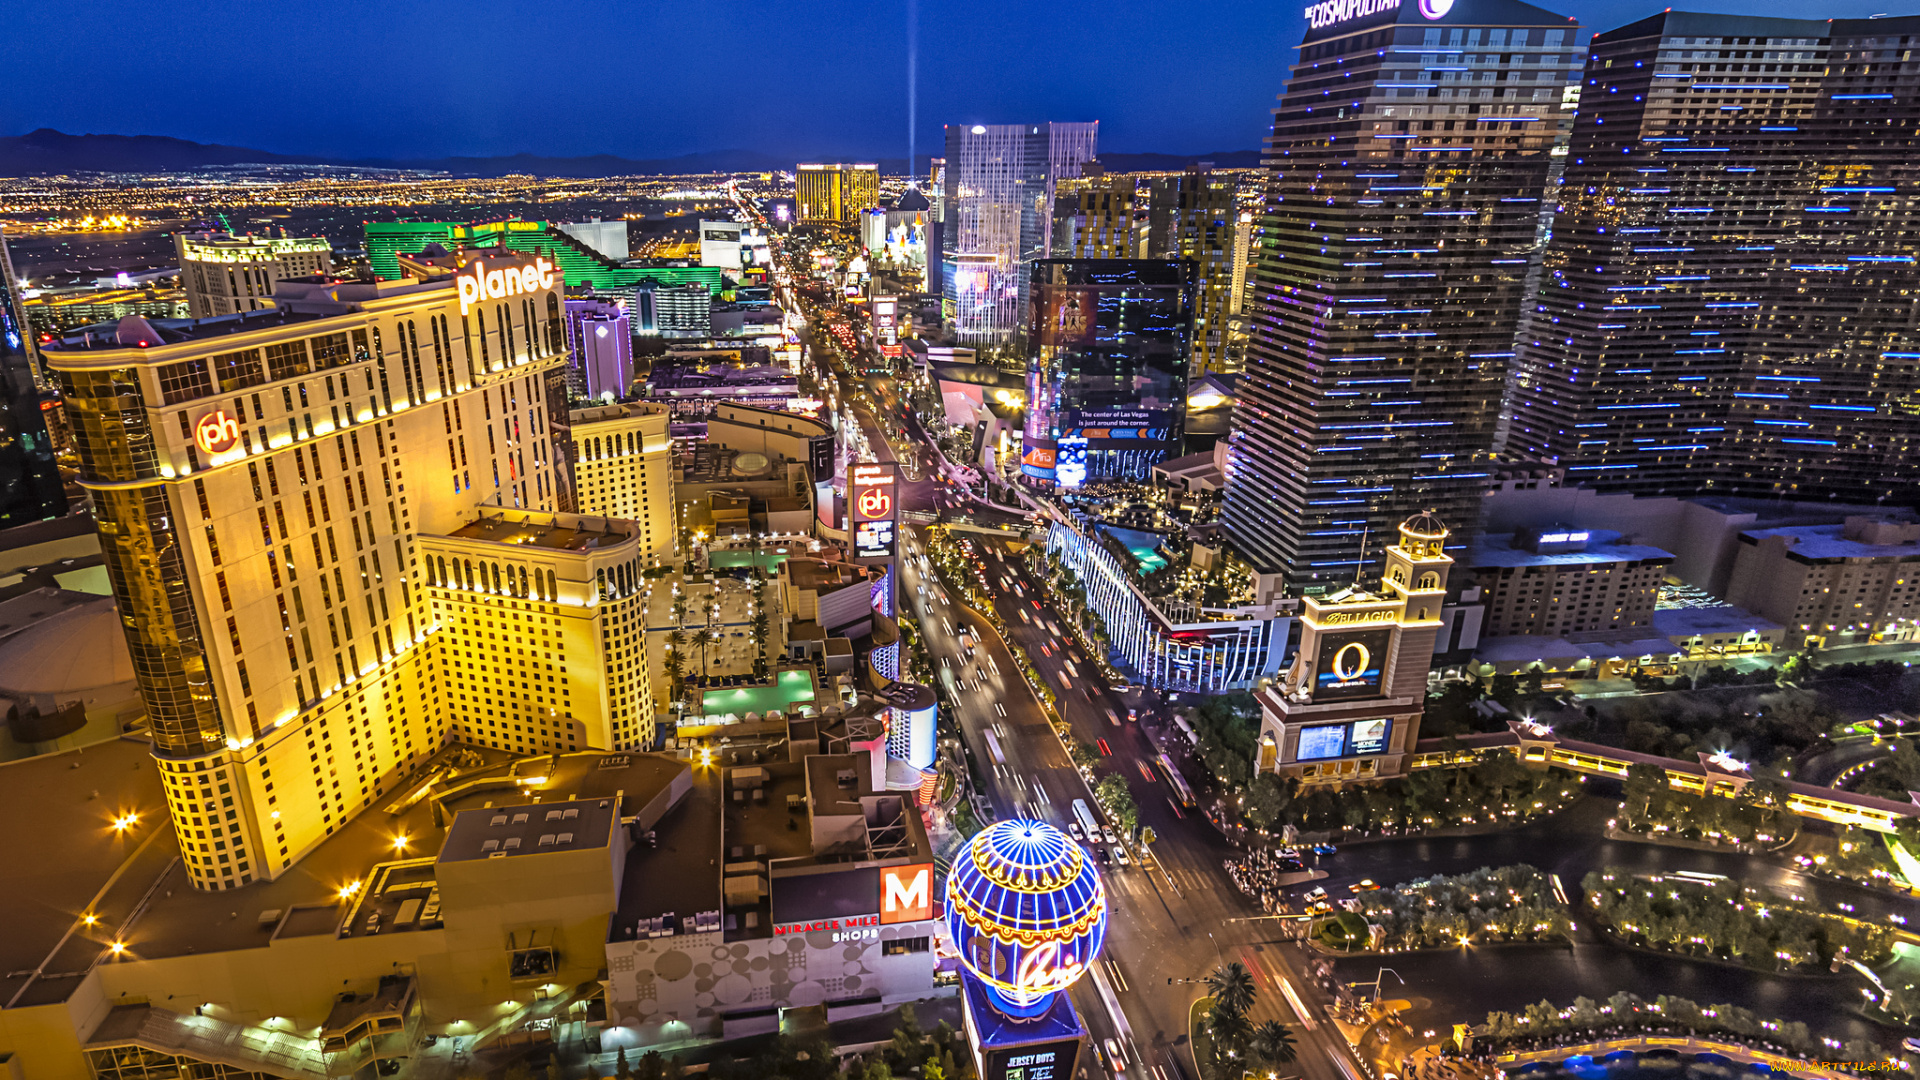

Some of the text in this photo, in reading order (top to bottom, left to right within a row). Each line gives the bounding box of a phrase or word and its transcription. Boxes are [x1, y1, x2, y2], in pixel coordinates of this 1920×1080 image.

[507, 221, 539, 231] GRAND
[457, 257, 554, 316] planet
[1131, 411, 1149, 419] Vegas
[201, 411, 239, 451] ph
[1032, 449, 1052, 463] Aria
[862, 488, 890, 515] ph
[1322, 610, 1395, 625] BELLAGIO
[1332, 642, 1370, 680] O
[885, 869, 929, 912] M
[774, 916, 878, 936] MIRACLE MILE
[832, 929, 879, 943] SHOPS
[1007, 1052, 1056, 1068] JERSEY BOYS
